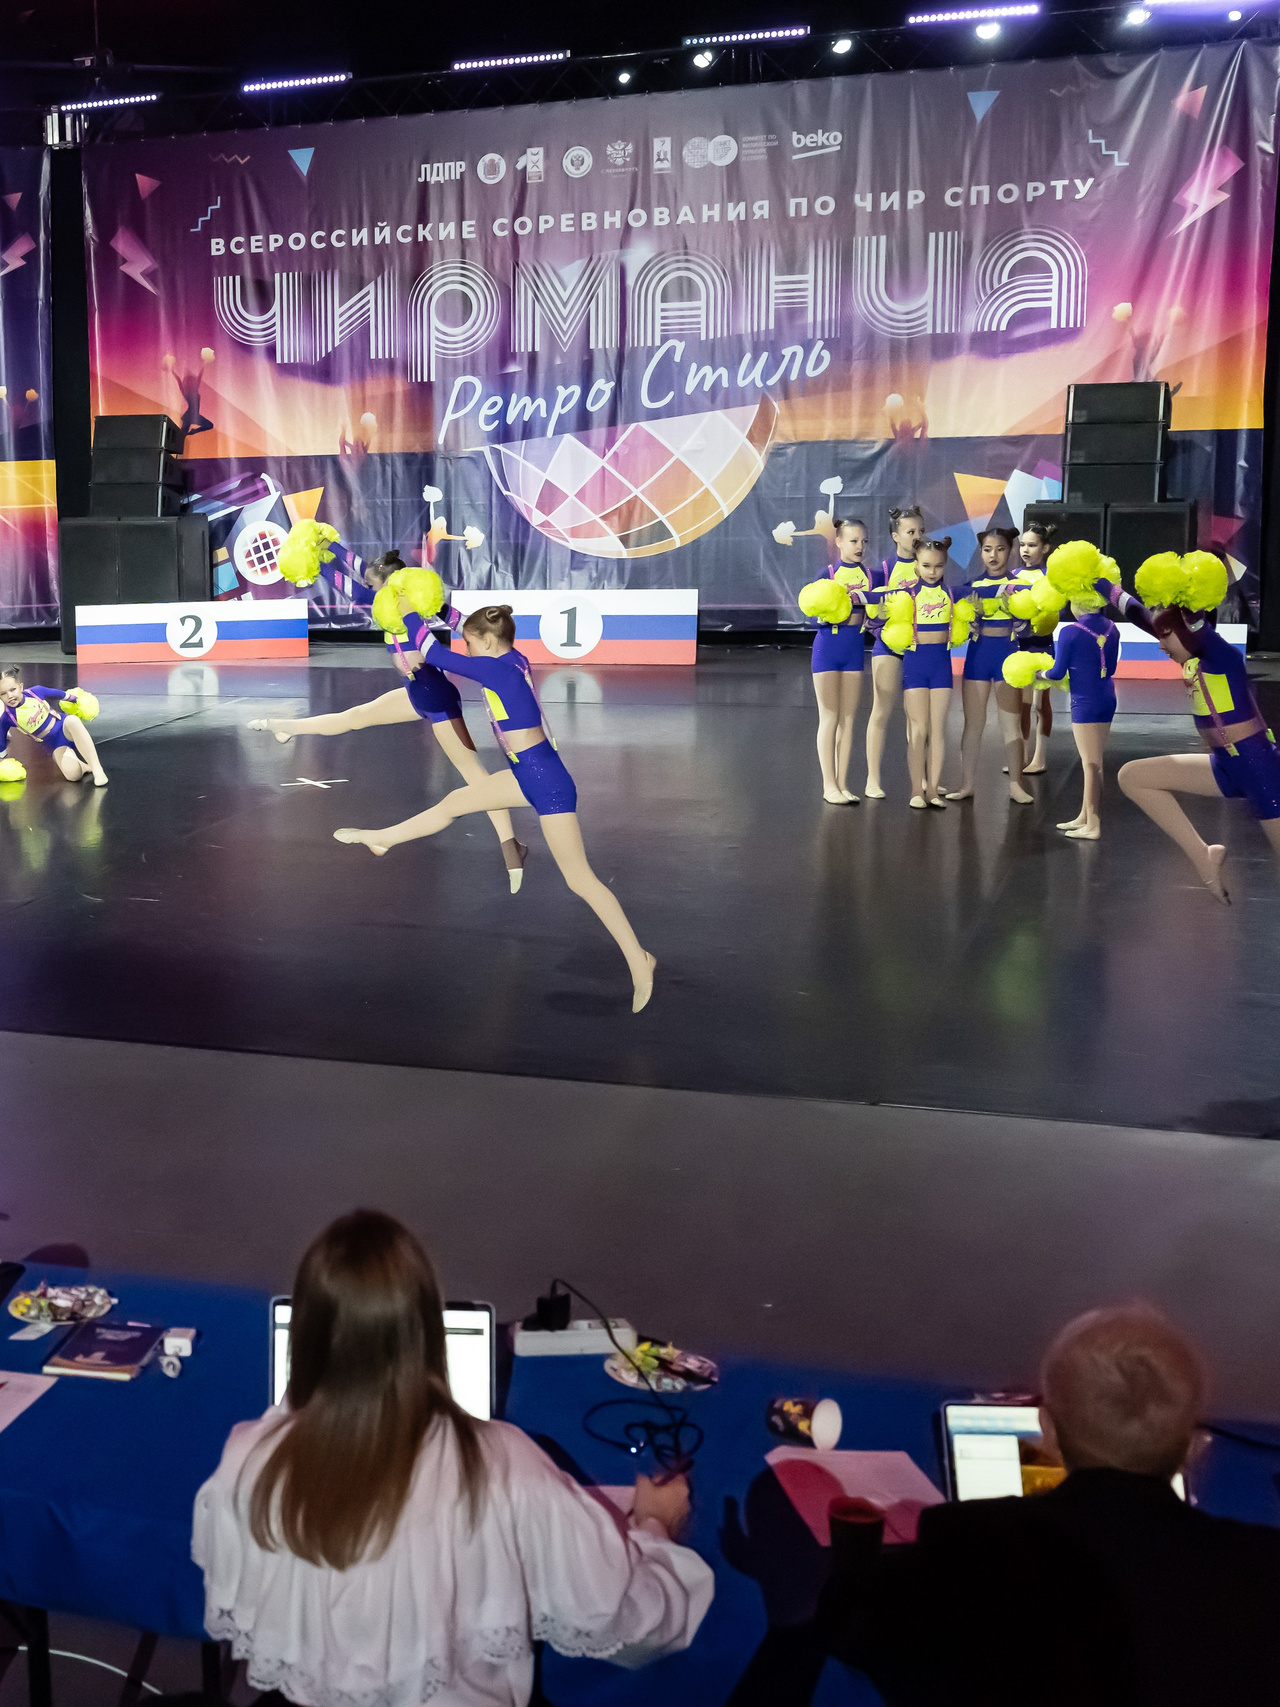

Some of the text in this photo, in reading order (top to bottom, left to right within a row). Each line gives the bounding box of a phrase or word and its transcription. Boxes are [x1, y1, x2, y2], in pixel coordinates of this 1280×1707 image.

[792, 129, 843, 148] beko
[418, 161, 466, 185] ЛДПР
[210, 177, 1095, 257] ВСЕРОССИЙСКИЕ СОРЕВНОВАНИЯ ПО ЧИР СПОРТУ
[439, 338, 832, 445] Ретро Стиль
[179, 614, 204, 649] 2
[559, 606, 583, 648] 1
